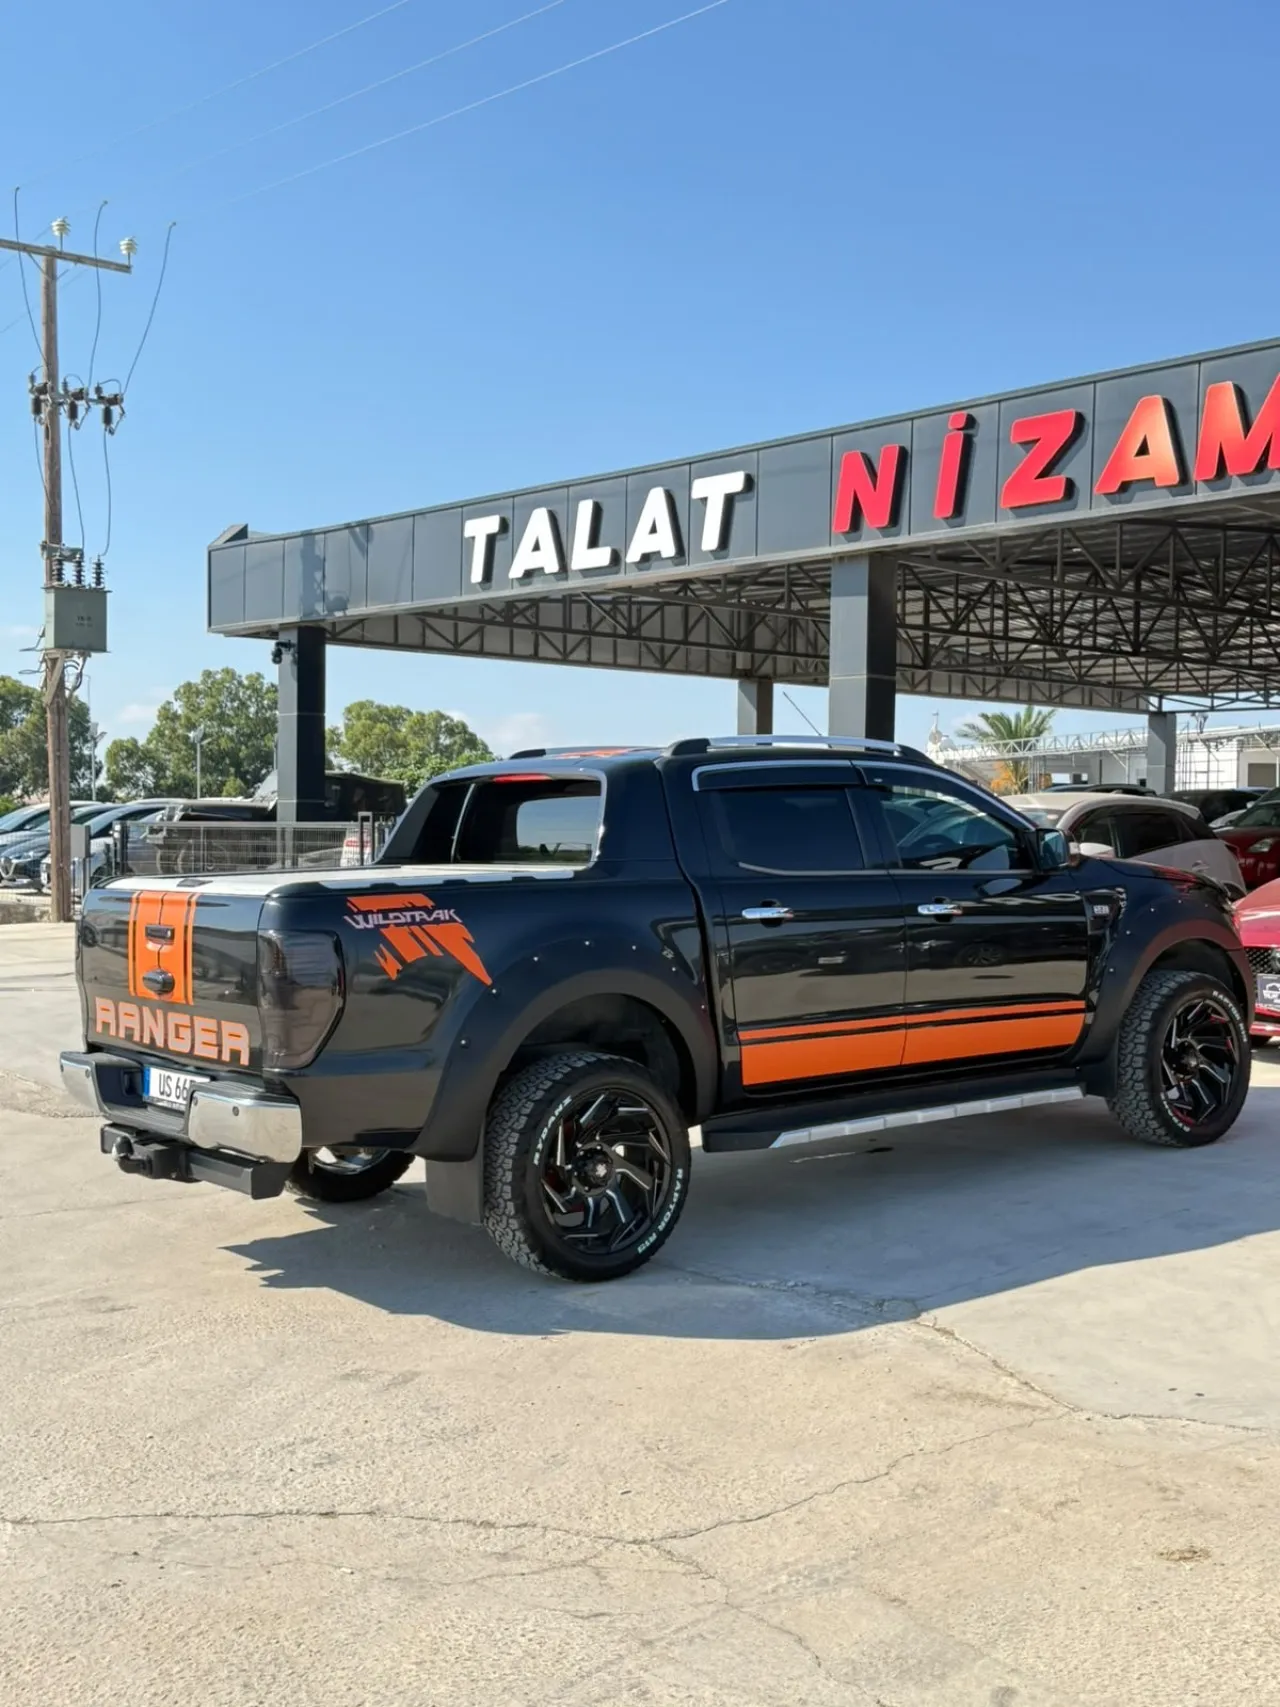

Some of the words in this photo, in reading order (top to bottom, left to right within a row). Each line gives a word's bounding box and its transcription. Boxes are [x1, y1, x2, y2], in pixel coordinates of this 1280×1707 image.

[463, 470, 748, 584] TALAT
[343, 908, 463, 930] WILDTRAK
[95, 996, 250, 1066] RANGER
[159, 1073, 172, 1097] US
[175, 1076, 196, 1101] 66
[657, 1168, 684, 1231] RAPTOR
